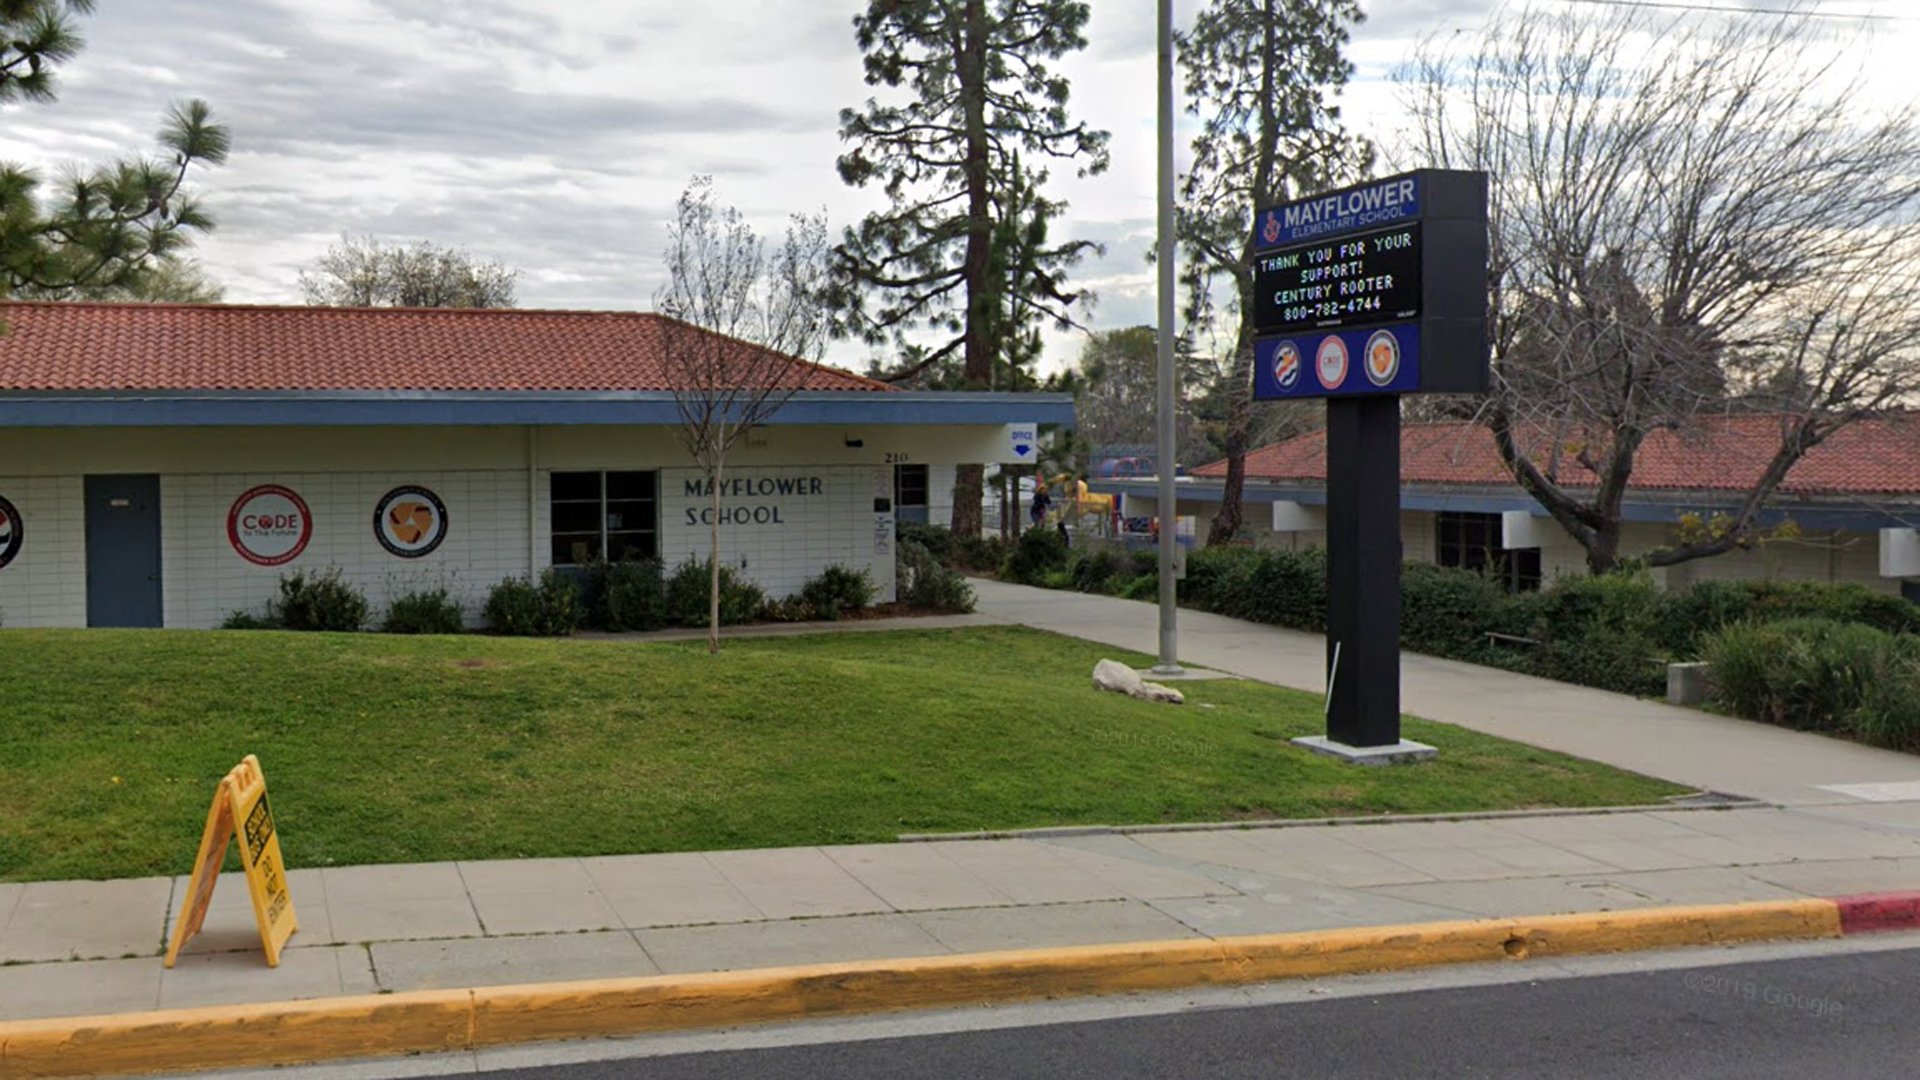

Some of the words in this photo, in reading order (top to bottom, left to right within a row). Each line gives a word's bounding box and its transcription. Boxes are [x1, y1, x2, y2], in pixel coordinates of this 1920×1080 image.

[1285, 179, 1415, 228] MAYFLOWER
[1292, 217, 1356, 239] ELEMENTARY
[1359, 206, 1406, 225] SCHOOL
[1261, 253, 1300, 272] THANK
[1307, 247, 1332, 264] YOU
[1340, 241, 1365, 258] FOR
[1374, 232, 1412, 252] YOUR
[1300, 260, 1364, 284] SUPPORT!
[1274, 284, 1333, 305] CENTURY
[1340, 275, 1394, 296] ROOTER
[1284, 295, 1382, 321] 800-782-4744
[885, 452, 909, 464] 210
[684, 477, 823, 497] MAYFLOWER
[243, 514, 297, 530] CODE
[685, 506, 785, 526] SCHOOL
